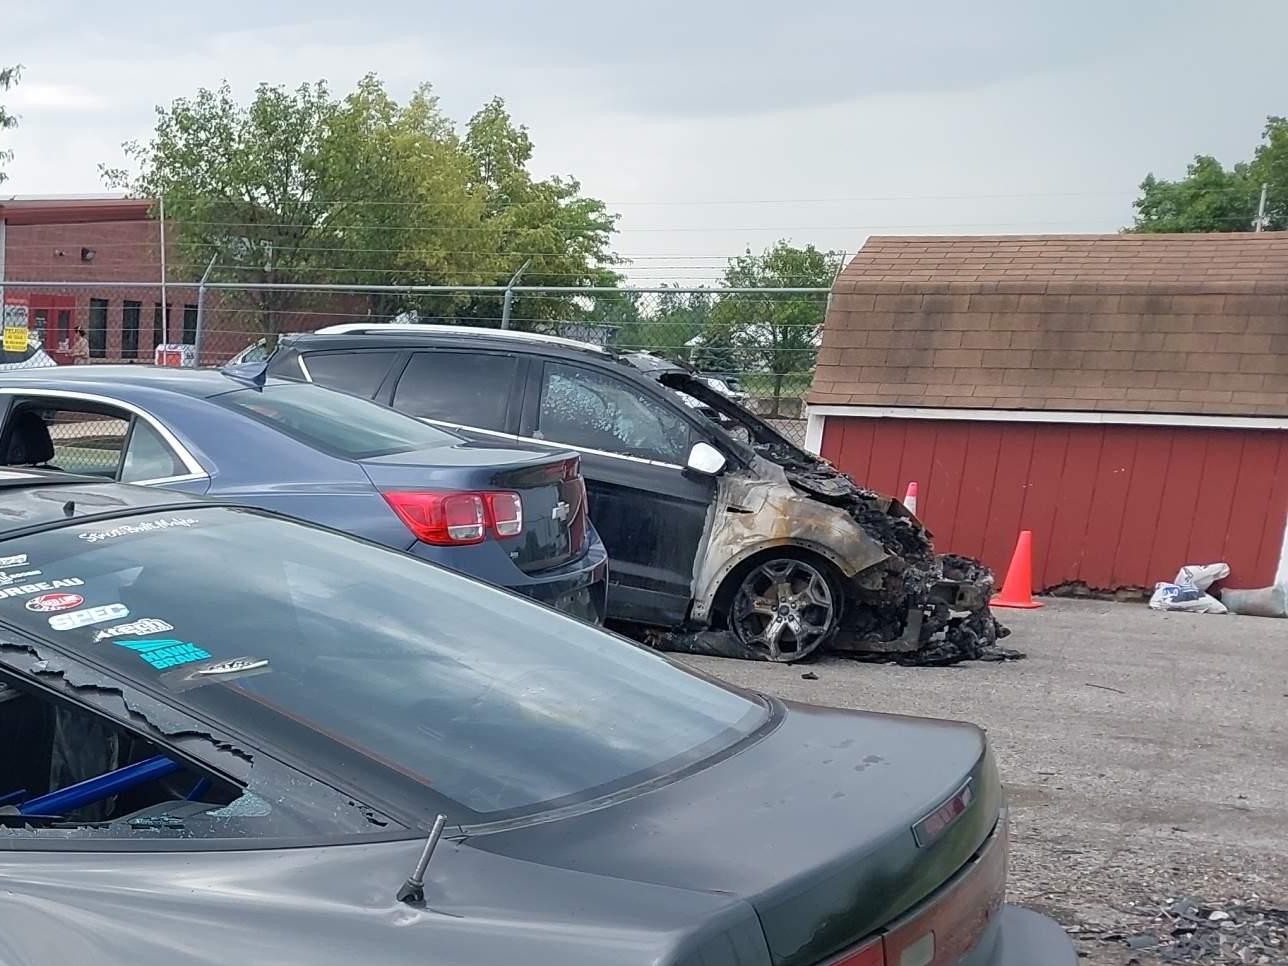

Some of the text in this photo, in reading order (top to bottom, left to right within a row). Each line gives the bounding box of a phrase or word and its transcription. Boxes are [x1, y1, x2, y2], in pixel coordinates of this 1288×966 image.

[53, 605, 127, 628] SPEC
[140, 642, 202, 662] HAWK
[150, 649, 212, 670] BRAKE
